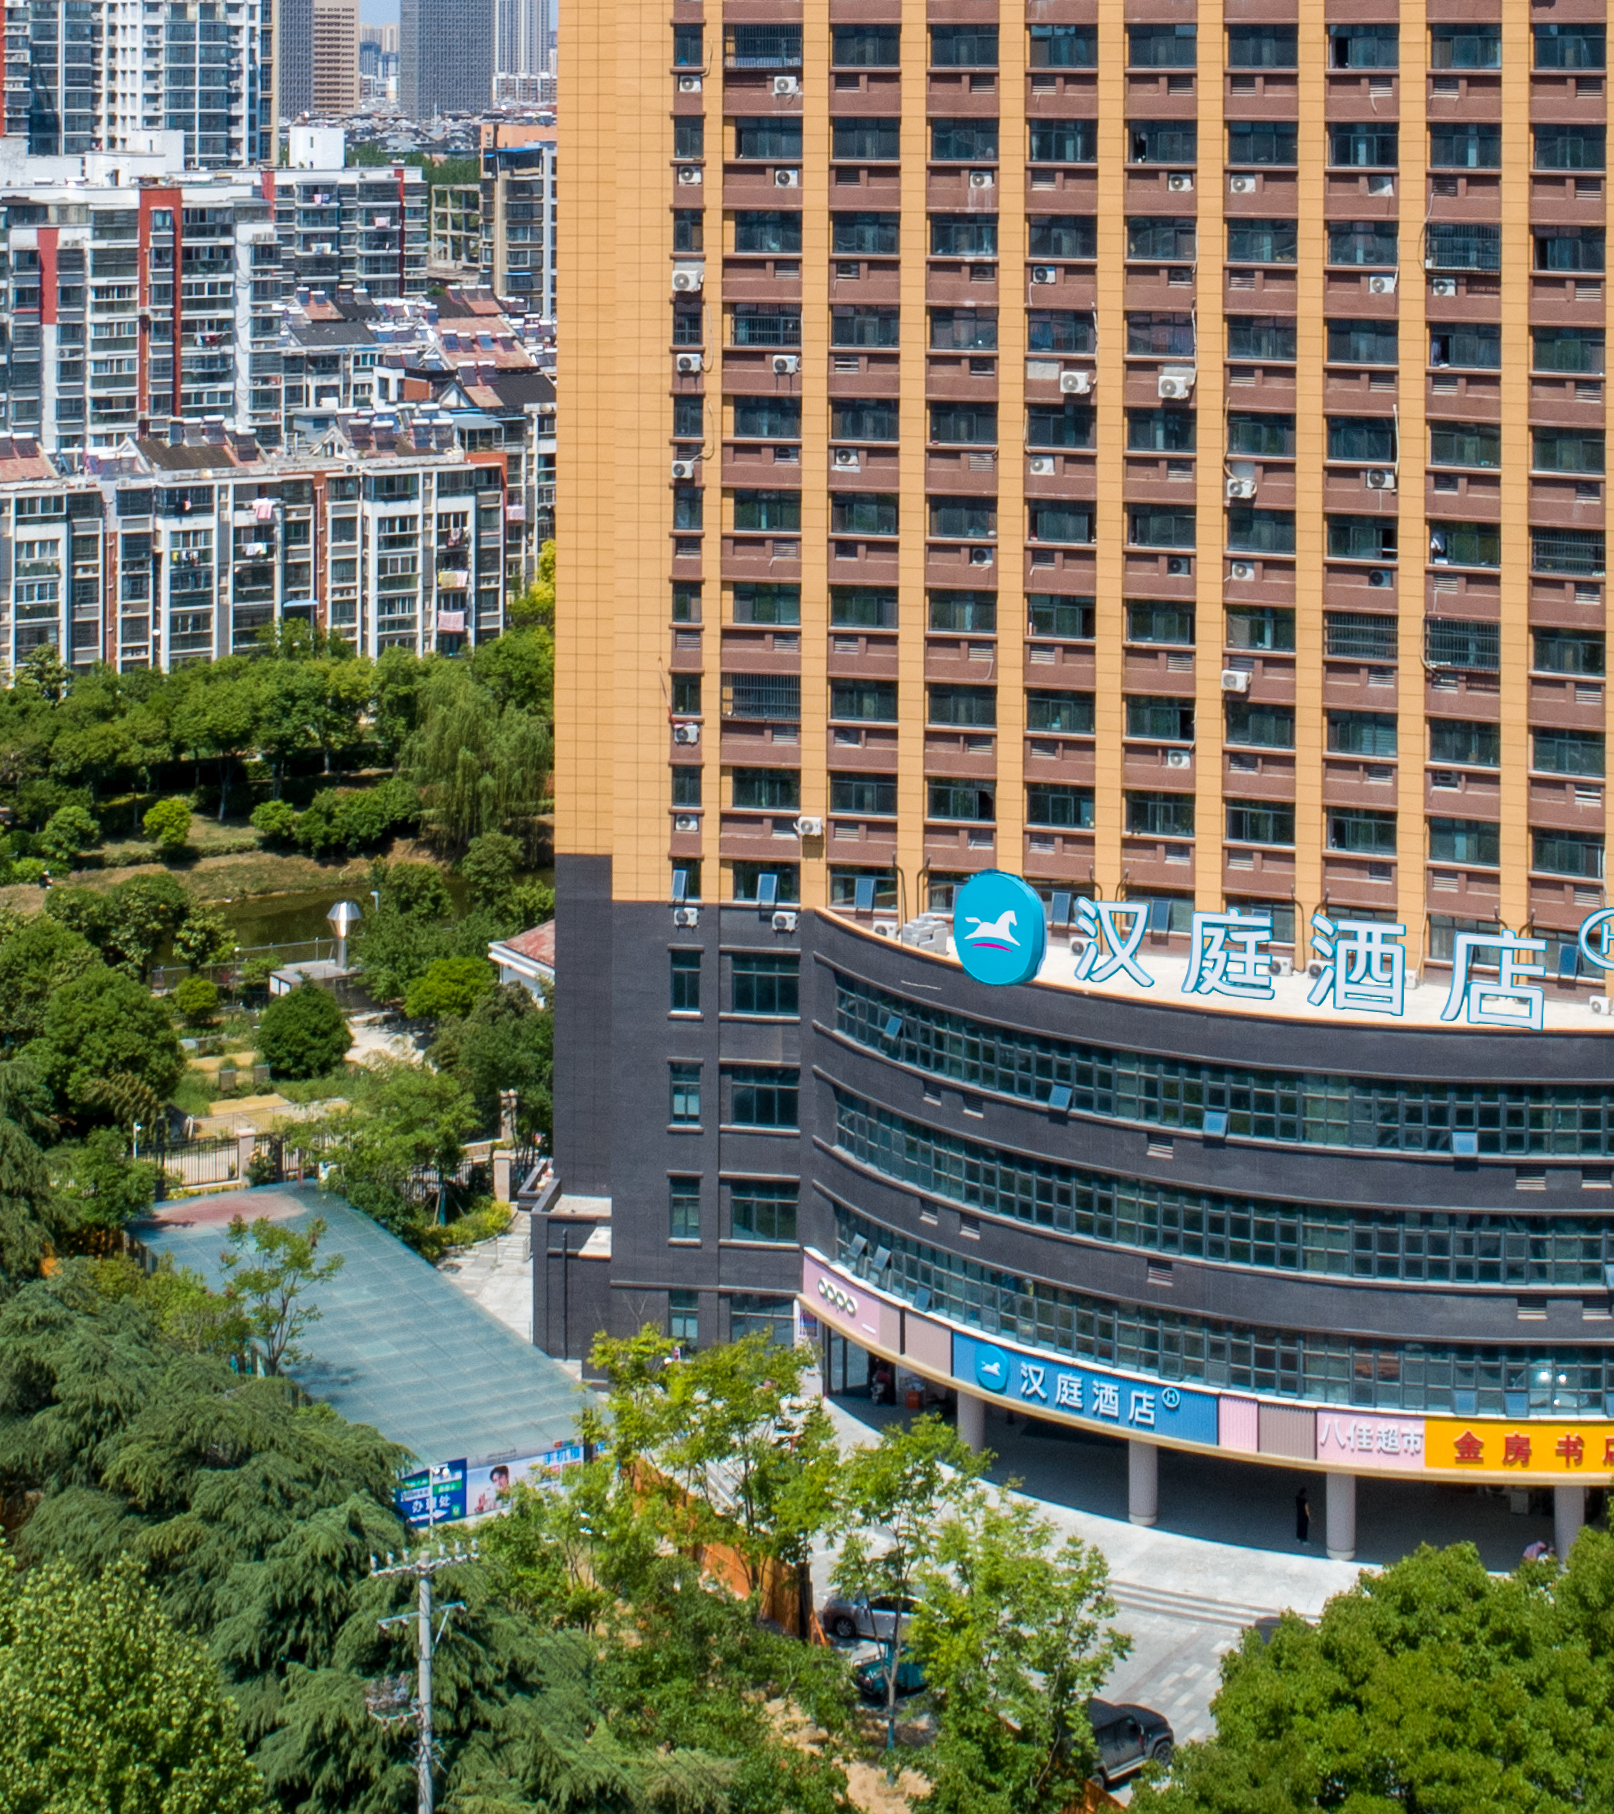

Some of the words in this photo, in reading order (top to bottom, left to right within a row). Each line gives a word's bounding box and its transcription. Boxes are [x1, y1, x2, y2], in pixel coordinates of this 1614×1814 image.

[1073, 895, 1547, 1031] 汉庭酒店
[1020, 1360, 1156, 1427] 汉庭酒店
[1319, 1418, 1425, 1456] 八佳超市
